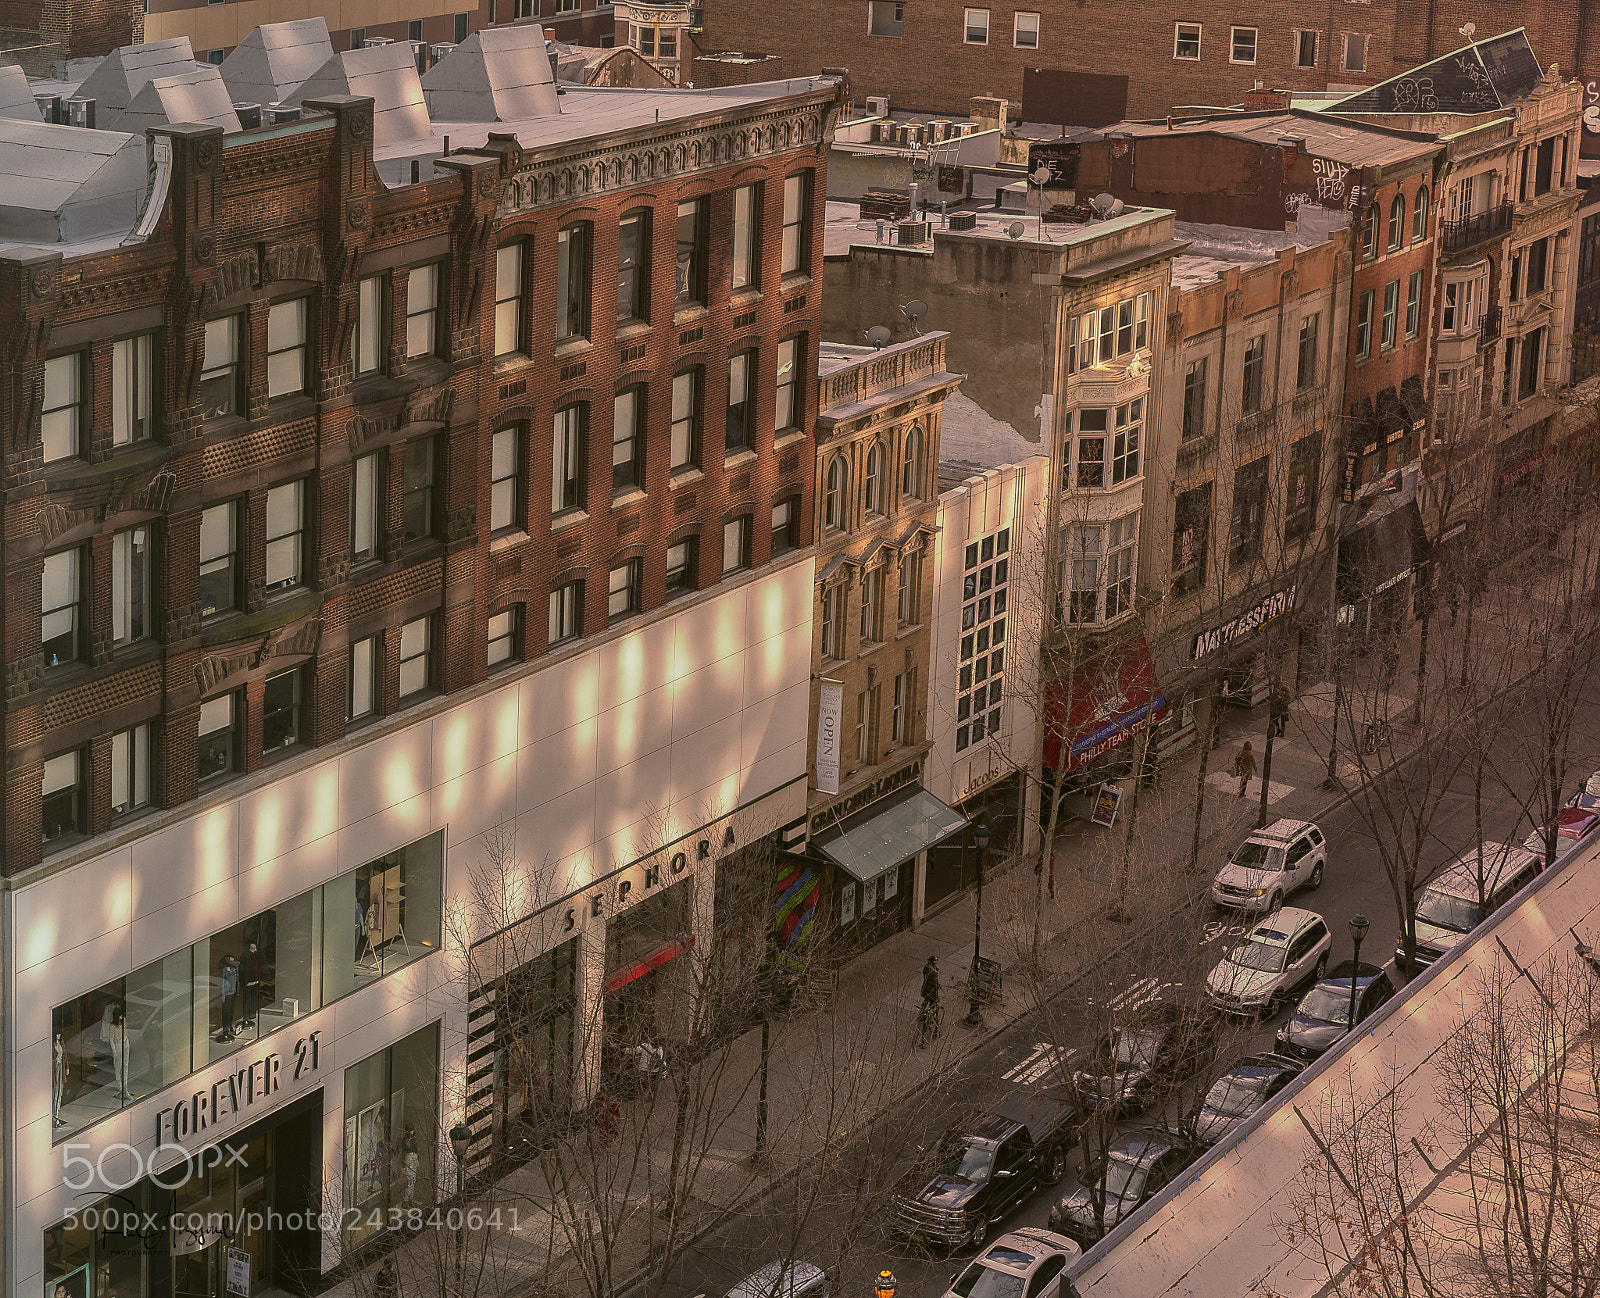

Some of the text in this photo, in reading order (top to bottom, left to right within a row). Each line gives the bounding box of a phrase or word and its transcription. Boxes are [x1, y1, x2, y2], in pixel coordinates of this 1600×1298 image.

[821, 707, 839, 716] NOW
[823, 716, 835, 756] OPEN
[1080, 741, 1107, 763] PHILLY
[1107, 730, 1129, 750] TEAM
[1131, 712, 1157, 735] STOE
[963, 751, 999, 794] Jacobs
[564, 826, 736, 932] SEPHORA
[156, 1030, 323, 1153] FOREVER 21
